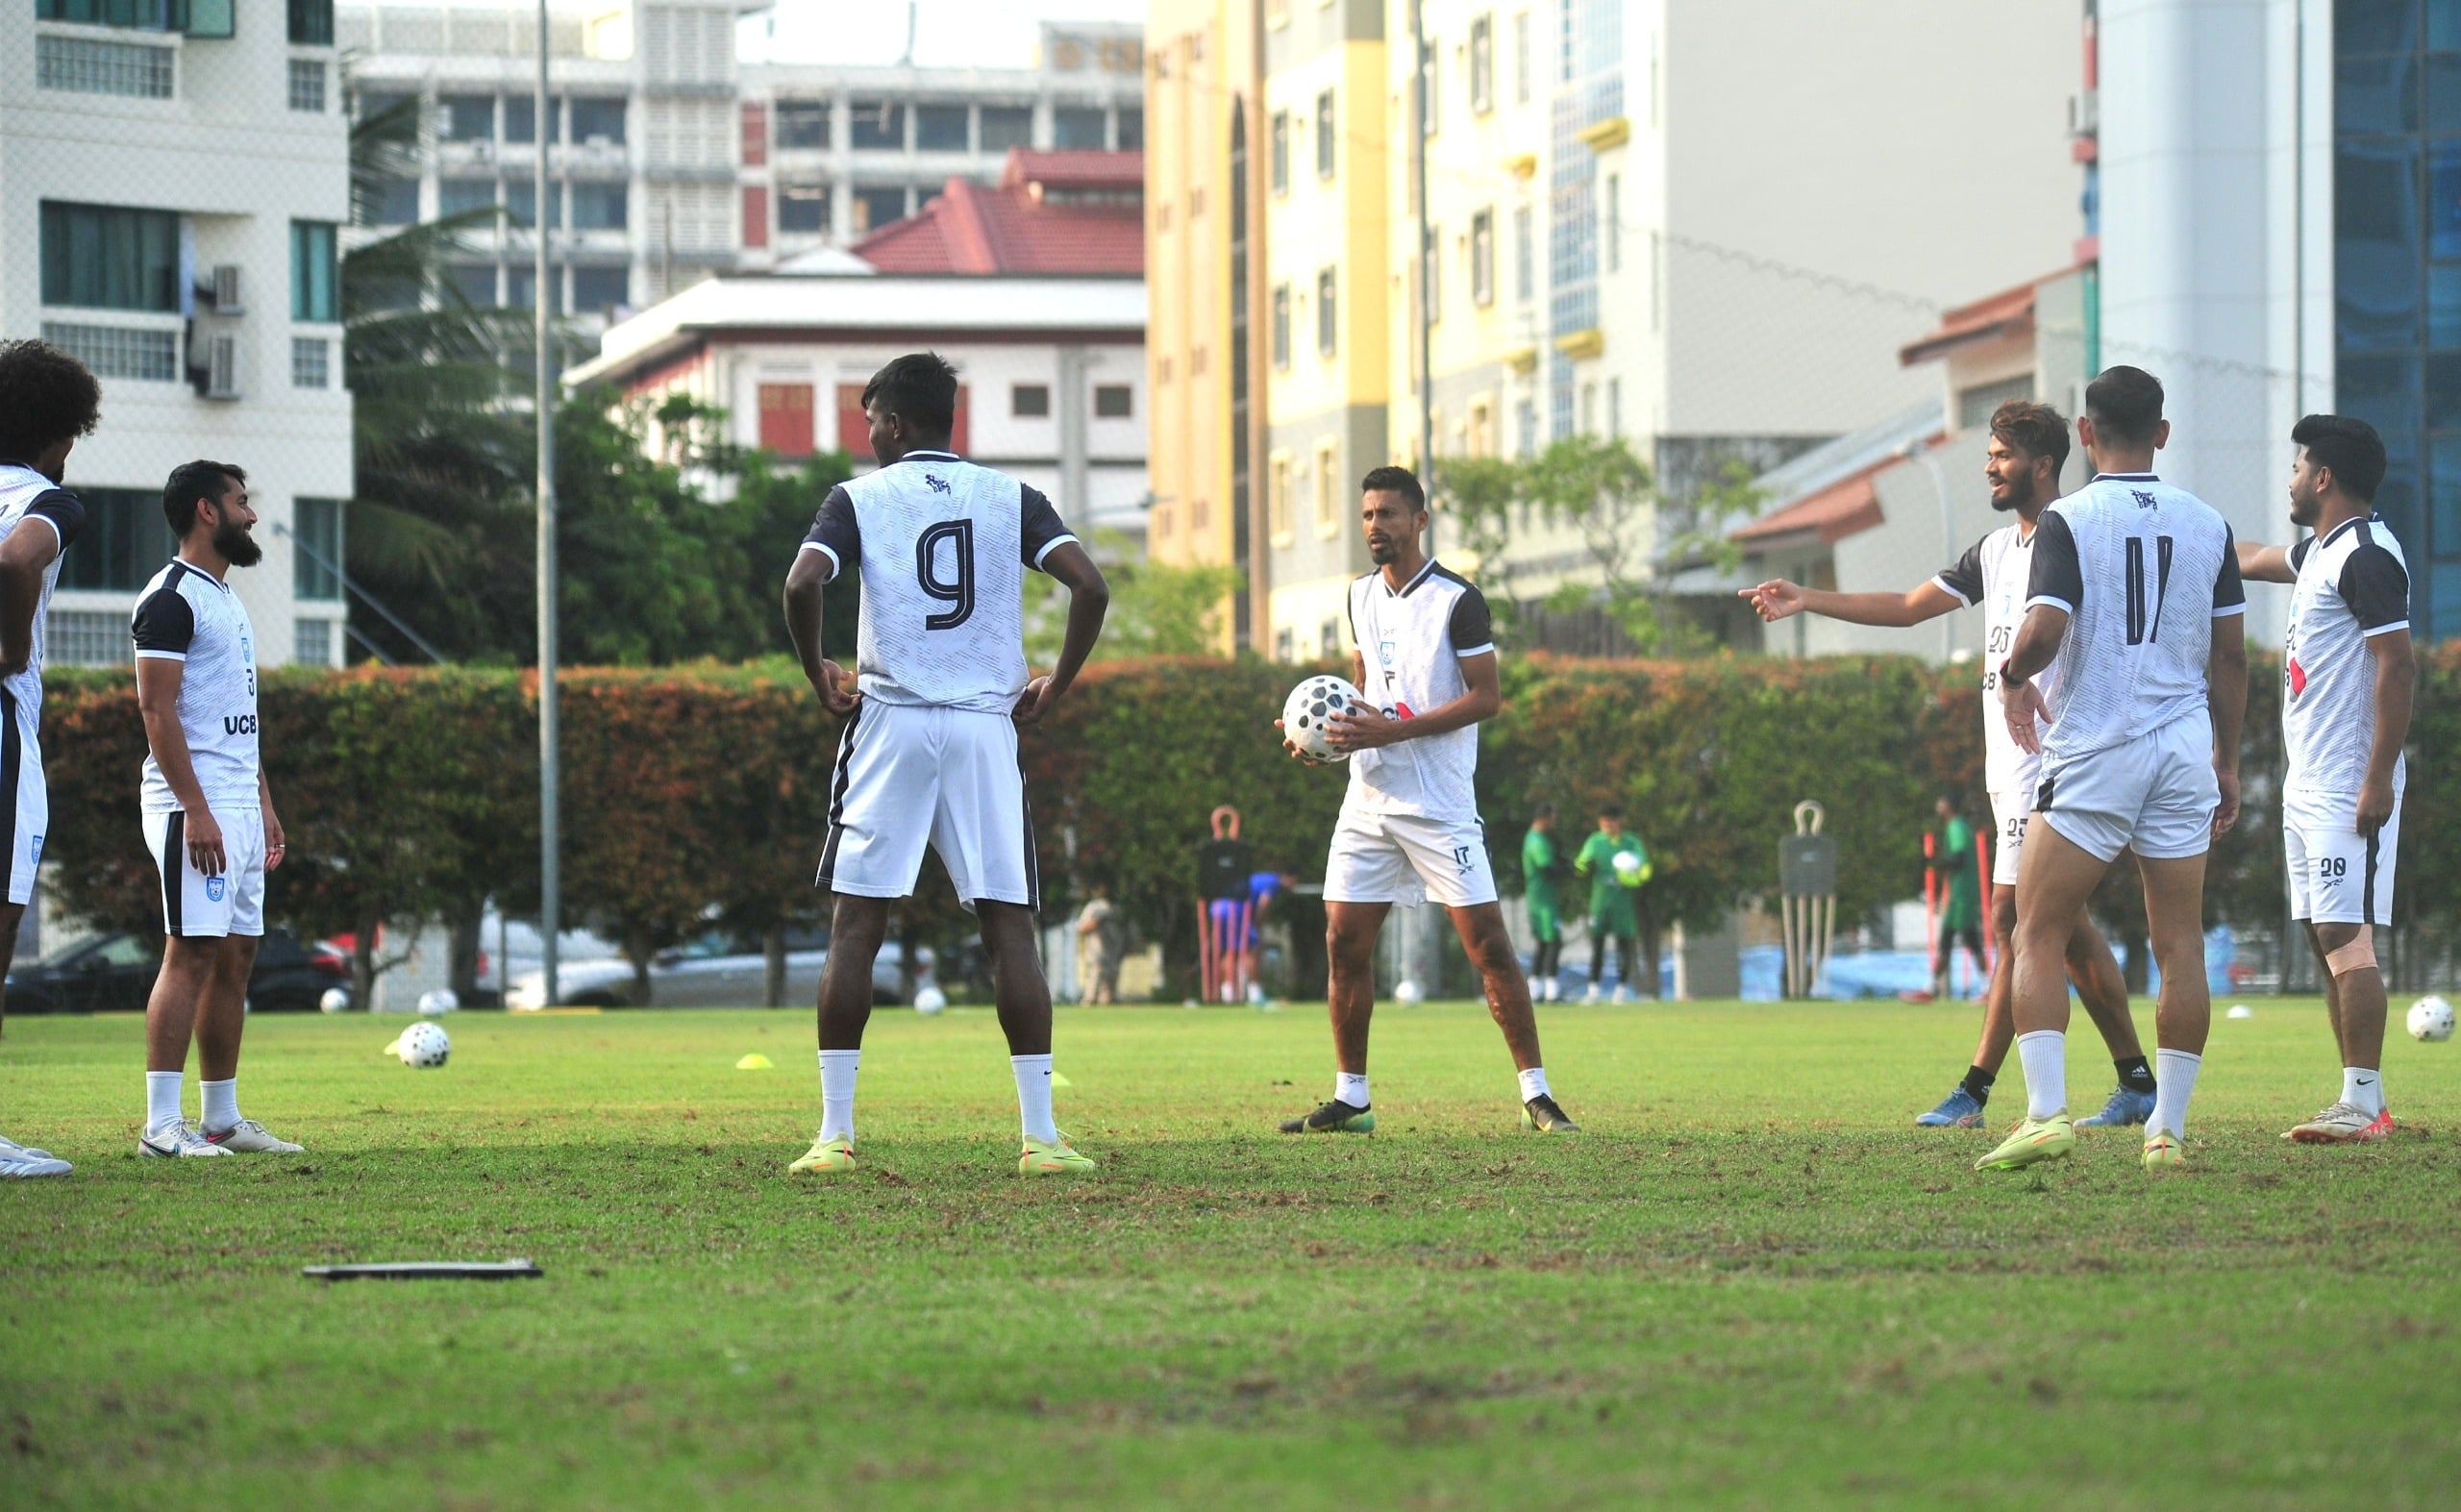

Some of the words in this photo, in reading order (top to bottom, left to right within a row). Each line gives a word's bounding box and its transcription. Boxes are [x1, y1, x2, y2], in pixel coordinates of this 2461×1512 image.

[915, 518, 976, 631] 9
[1988, 625, 2012, 654] 25
[224, 714, 257, 736] UCB
[2321, 856, 2347, 878] 20
